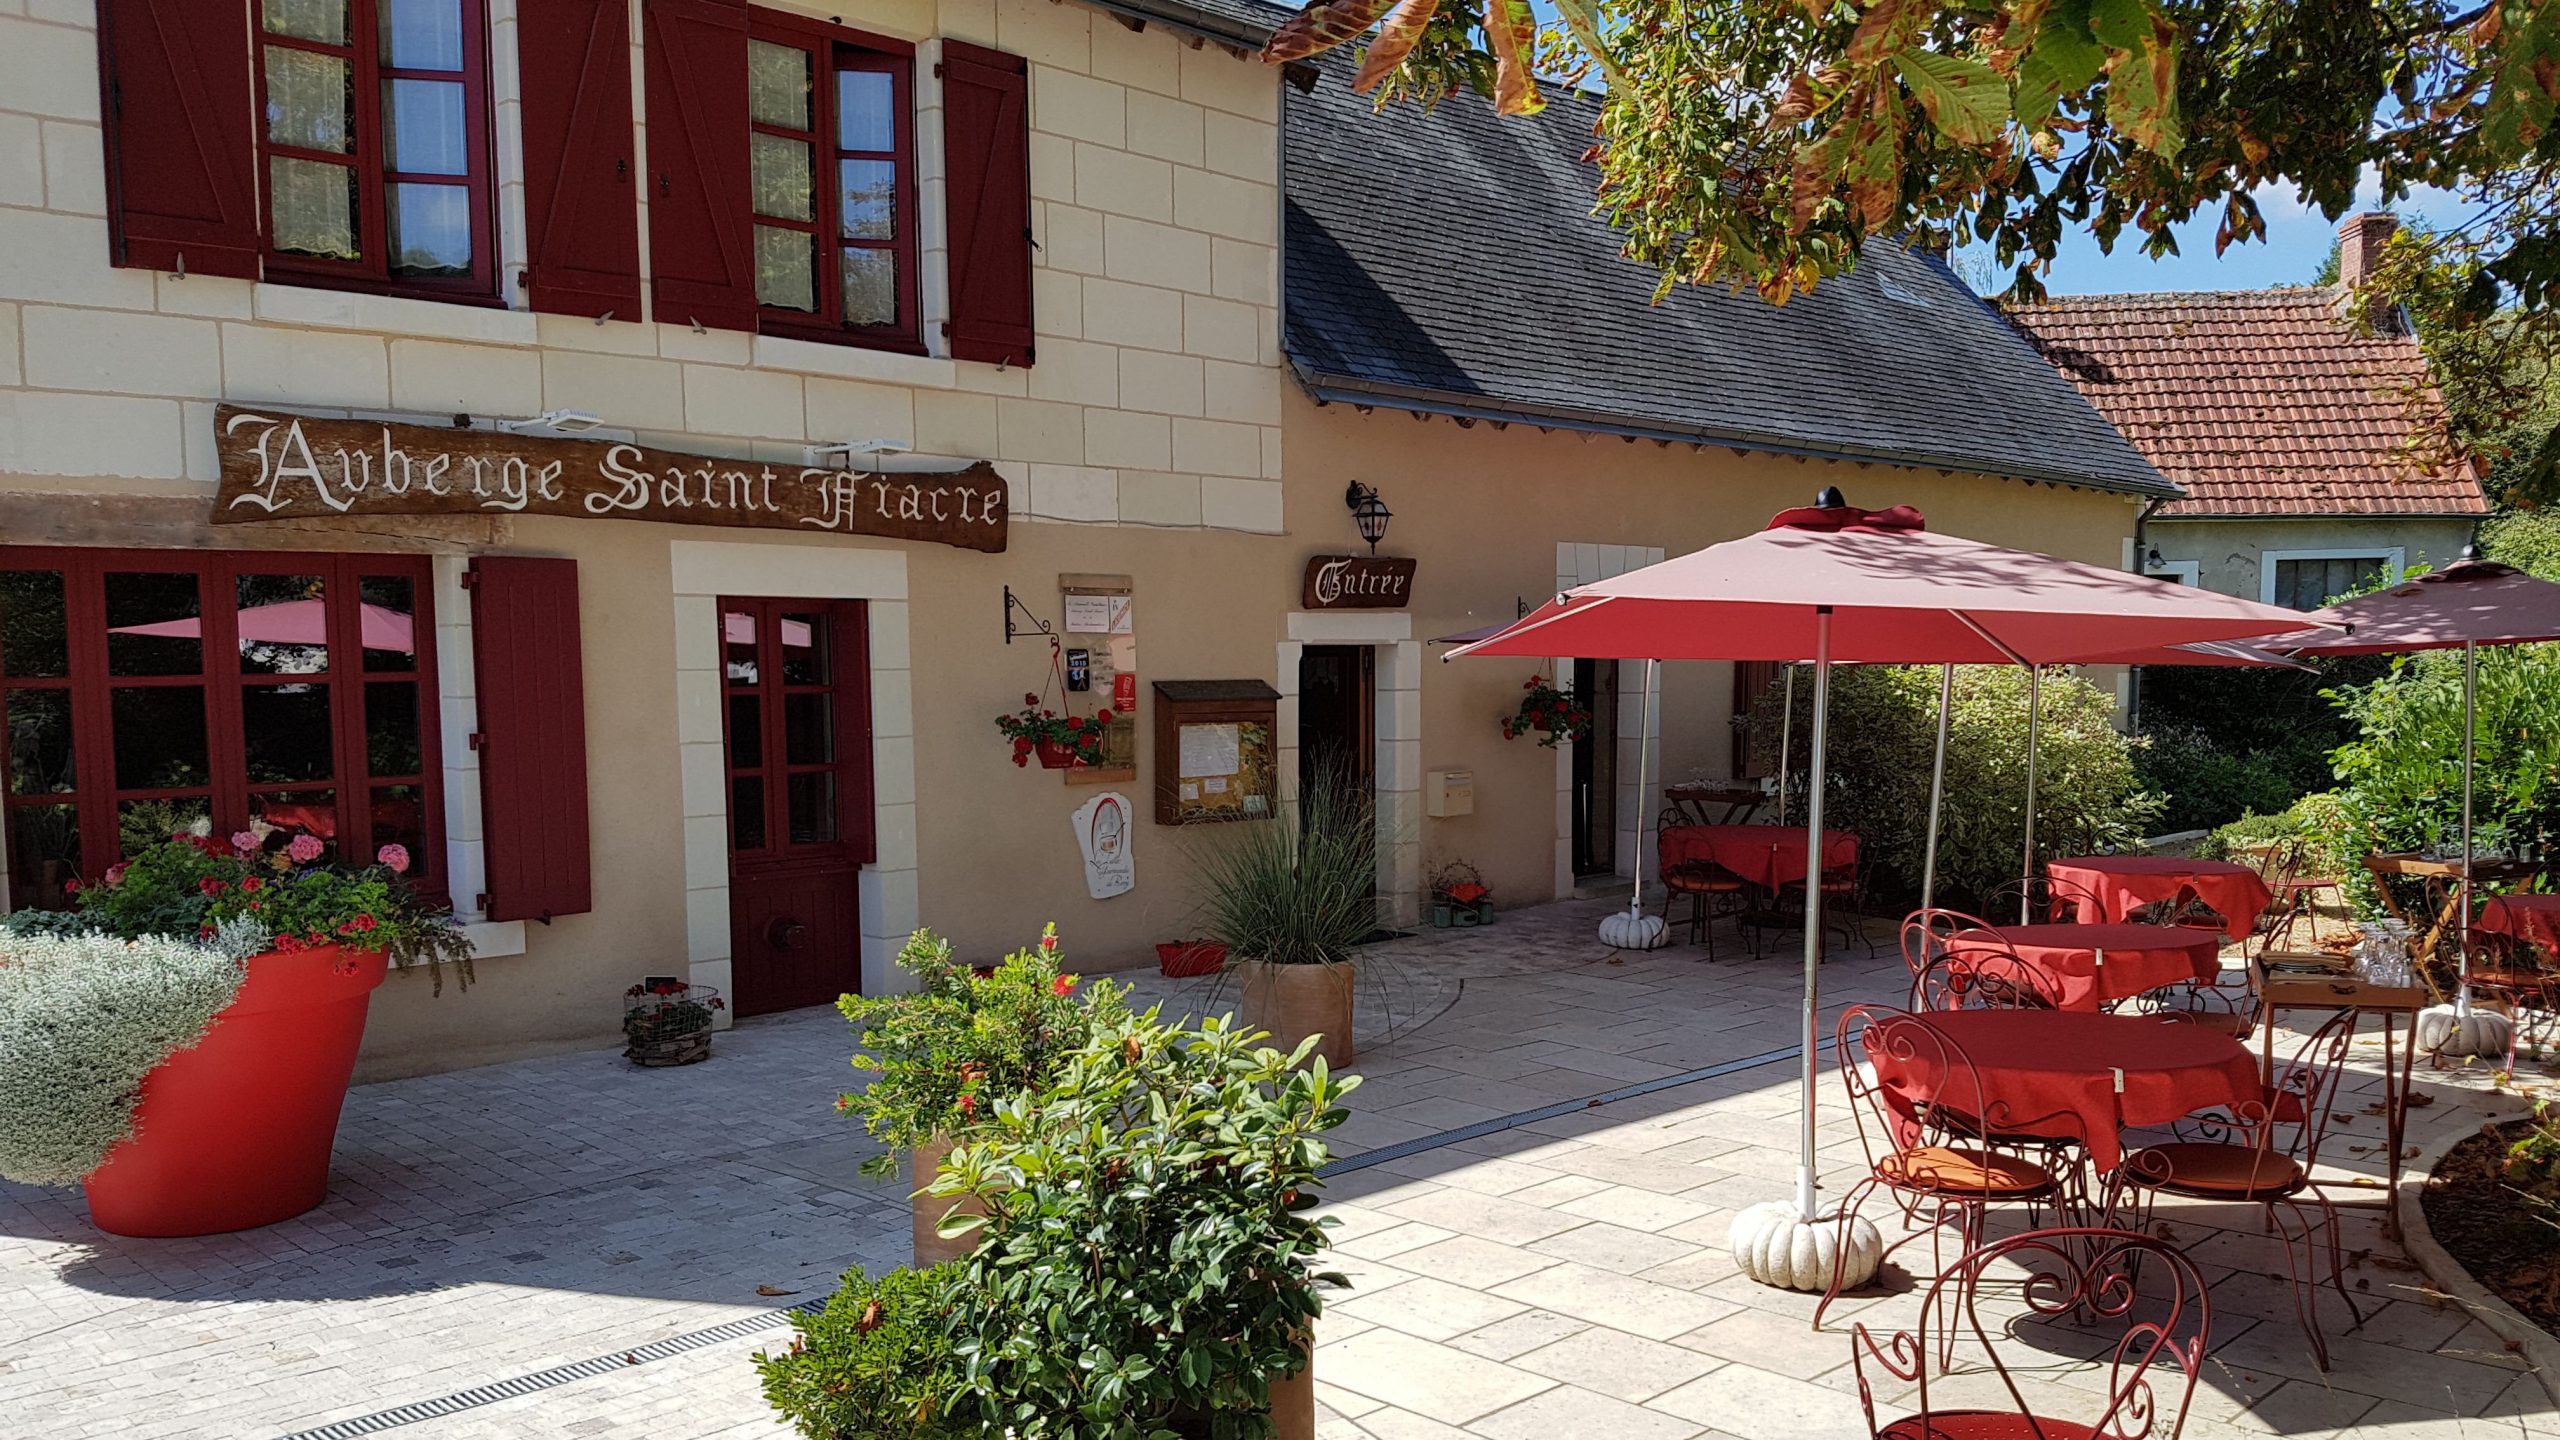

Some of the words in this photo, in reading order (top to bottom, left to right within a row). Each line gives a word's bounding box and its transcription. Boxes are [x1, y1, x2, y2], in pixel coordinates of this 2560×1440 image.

[226, 414, 564, 512] Auberge
[584, 445, 780, 514] Saint
[800, 469, 1002, 530] Fiacre
[1315, 558, 1405, 606] Entrée
